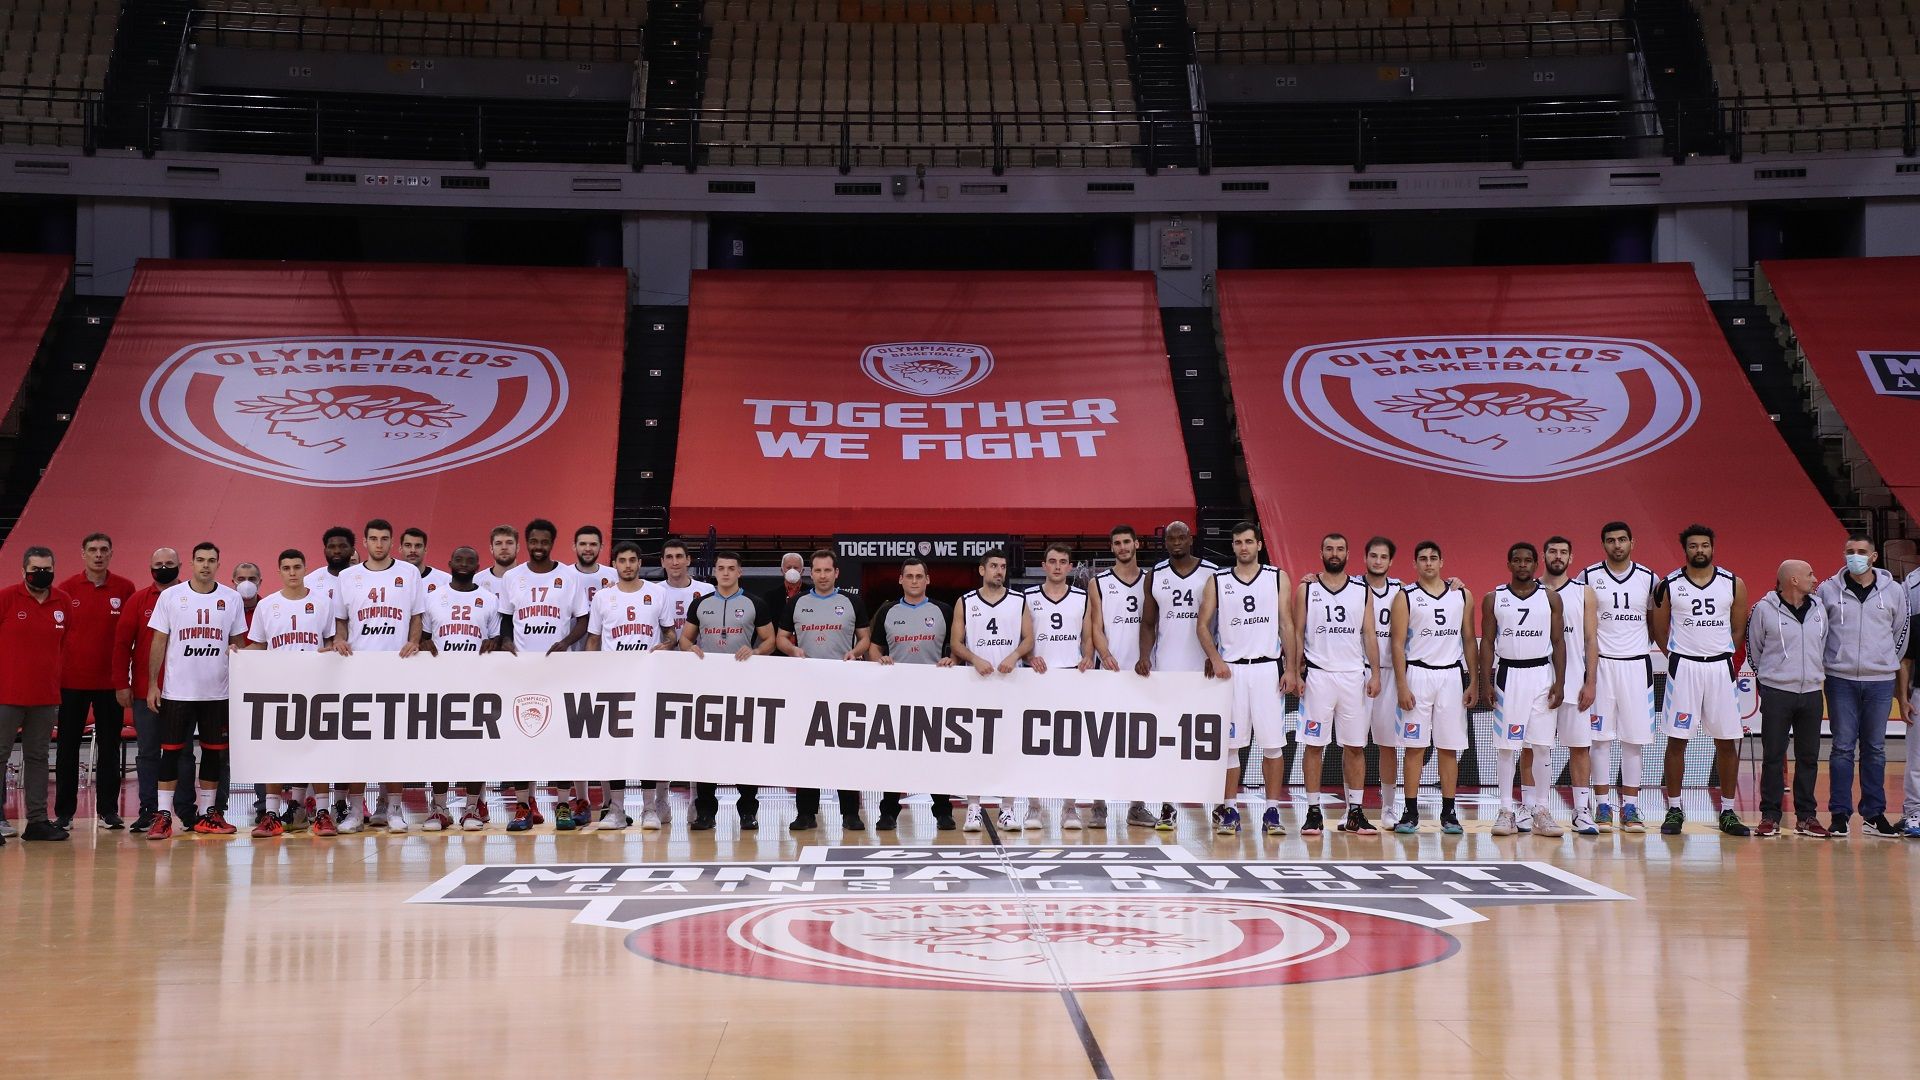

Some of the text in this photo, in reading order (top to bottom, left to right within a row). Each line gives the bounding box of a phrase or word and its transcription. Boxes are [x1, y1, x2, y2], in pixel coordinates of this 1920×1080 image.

[213, 347, 519, 368] OLYMPIACOS
[877, 346, 976, 354] OLYMPIACOS
[1329, 346, 1624, 367] OLYMPIACOS
[253, 363, 474, 379] BASKETBALL
[1372, 361, 1590, 377] BASKETBALL
[743, 398, 1119, 428] TOGETHER
[382, 431, 440, 441] 1925
[1536, 426, 1592, 434] 1925
[755, 430, 1106, 460] WE FIGHT
[838, 541, 916, 556] TOGETHER
[934, 541, 957, 556] WE
[368, 587, 385, 603] 41
[531, 587, 548, 602] 17
[1173, 589, 1193, 606] 24
[1613, 592, 1630, 609] 11
[676, 601, 684, 615] 5
[1126, 596, 1138, 612] 3
[1243, 596, 1255, 612] 8
[1692, 599, 1715, 615] 25
[197, 609, 210, 624] 11
[358, 606, 403, 621] OLYMPIACOS
[451, 606, 471, 621] 22
[518, 605, 561, 620] OLYMPIACOS
[627, 606, 635, 621] 6
[1325, 606, 1345, 622] 13
[1435, 609, 1446, 625] 5
[1518, 609, 1530, 625] 7
[291, 614, 296, 630] 1
[524, 622, 556, 635] bwin
[986, 618, 998, 634] 4
[1051, 613, 1062, 629] 9
[1244, 617, 1269, 625] AEGEAN
[178, 627, 223, 642] OLYMPIACOS
[362, 623, 395, 636] bwin
[439, 624, 482, 639] OLYMPIACOS
[611, 624, 653, 638] OLYMPIACOS
[704, 626, 743, 634] Palalast
[272, 632, 318, 649] OLYMPIACOS
[444, 639, 476, 651] bwin
[616, 640, 648, 651] bwin
[895, 634, 936, 642] Palaplast
[184, 644, 220, 657] bwin
[243, 692, 1222, 760] TOGETHER WE FIGHT AGAINST COVID-19
[499, 866, 1501, 882] MONDAY NIGHT
[484, 880, 1551, 894] AGAINST COVID-19
